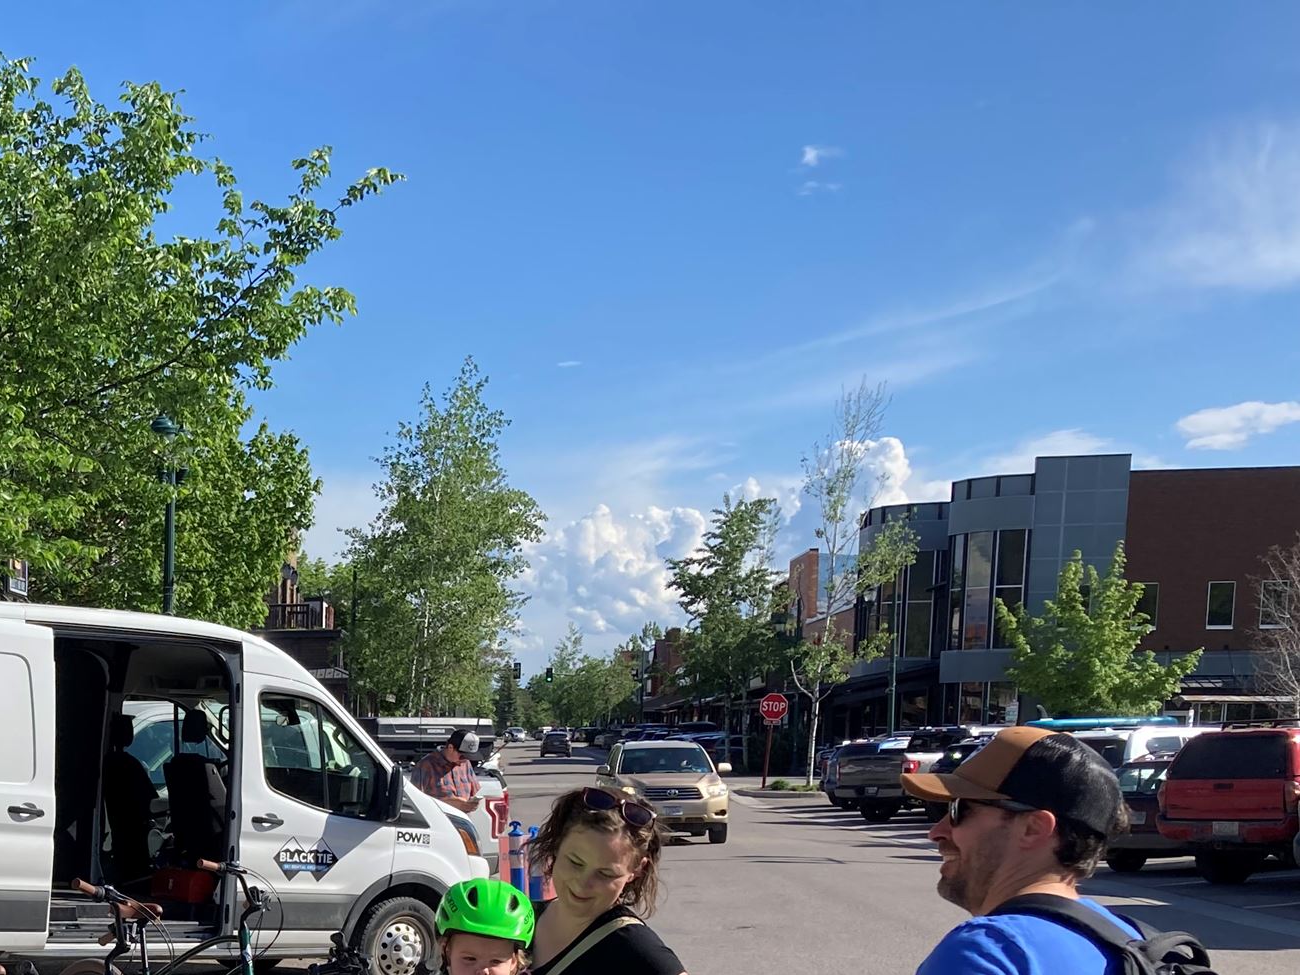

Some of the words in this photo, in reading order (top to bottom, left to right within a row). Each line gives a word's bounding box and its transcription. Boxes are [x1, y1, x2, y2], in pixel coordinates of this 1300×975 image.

[762, 701, 786, 712] STOP
[396, 831, 423, 843] POW
[279, 851, 315, 864] BLACK
[317, 853, 333, 864] TIE
